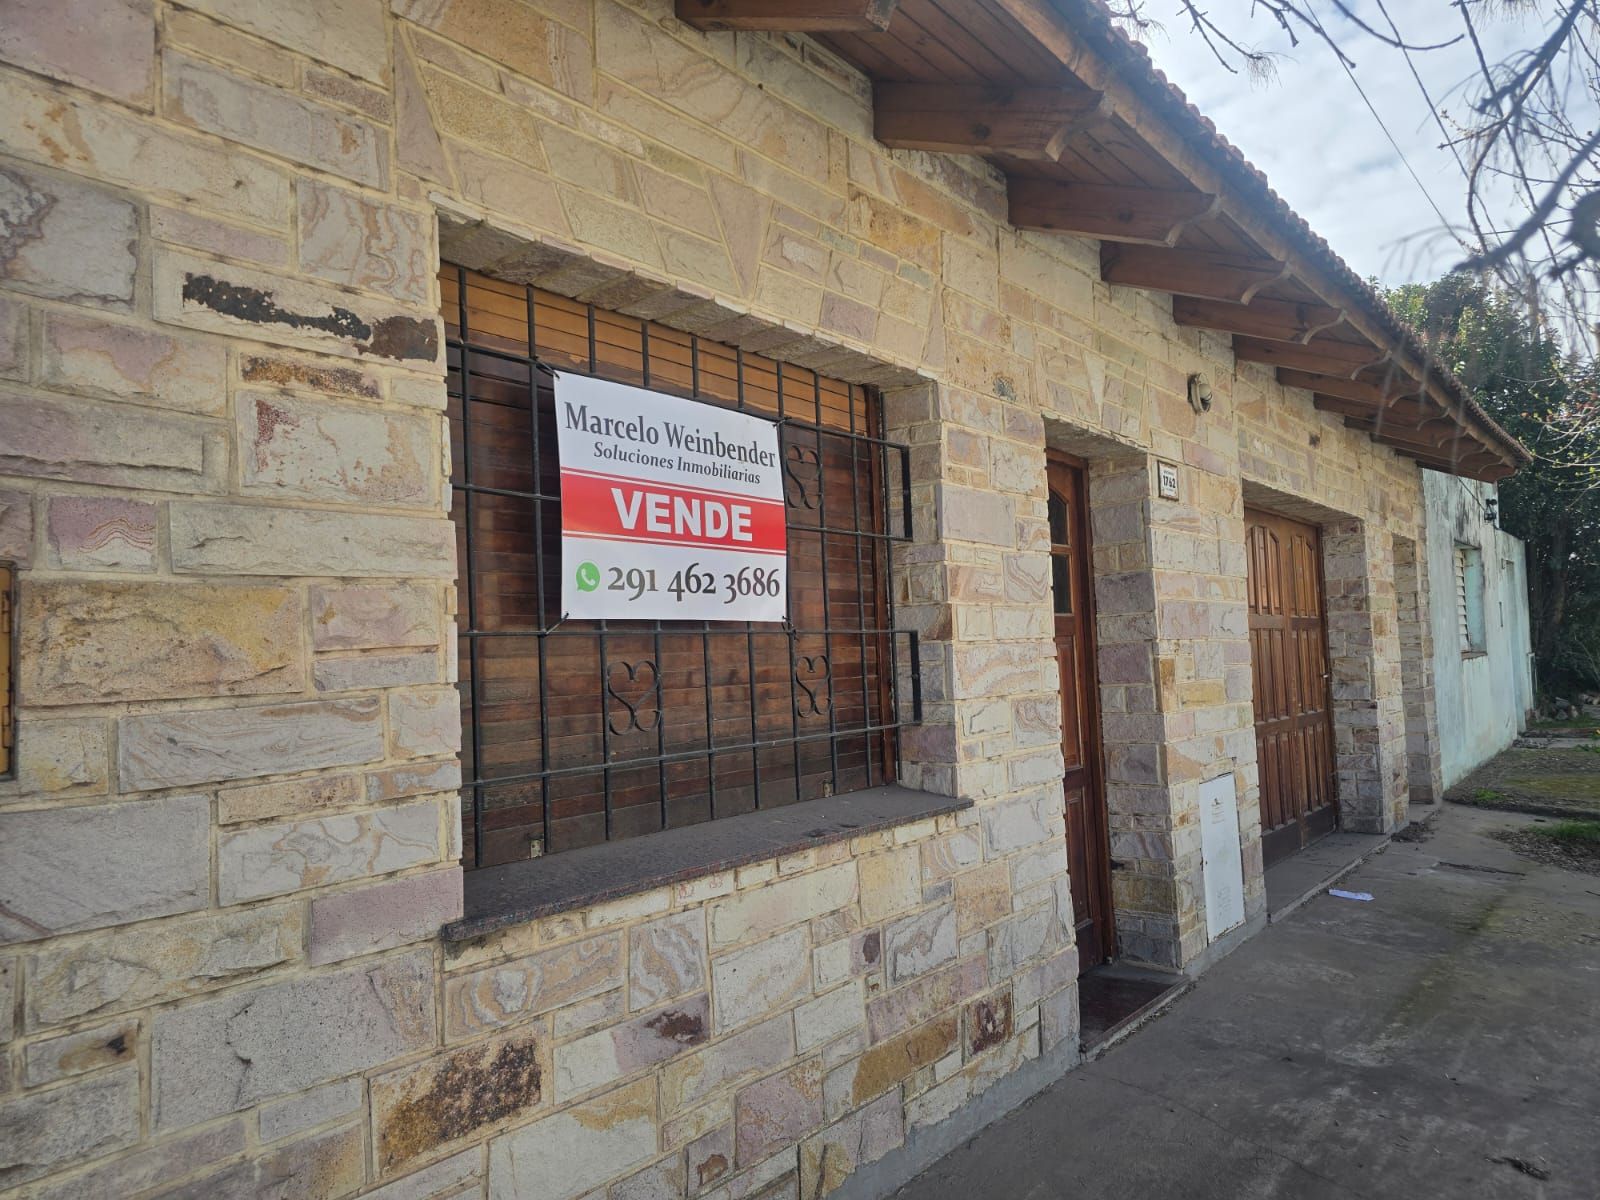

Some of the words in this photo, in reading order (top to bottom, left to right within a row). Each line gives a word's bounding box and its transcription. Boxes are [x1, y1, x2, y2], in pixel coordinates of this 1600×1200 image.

[564, 401, 659, 445] Marcelo
[664, 421, 776, 468] Weinbender
[594, 441, 674, 469] Soluciones
[677, 456, 761, 484] Inmobiliarias
[610, 487, 753, 542] VENDE
[607, 566, 659, 601] 291
[667, 562, 716, 602] 462
[723, 566, 781, 604] 3686
